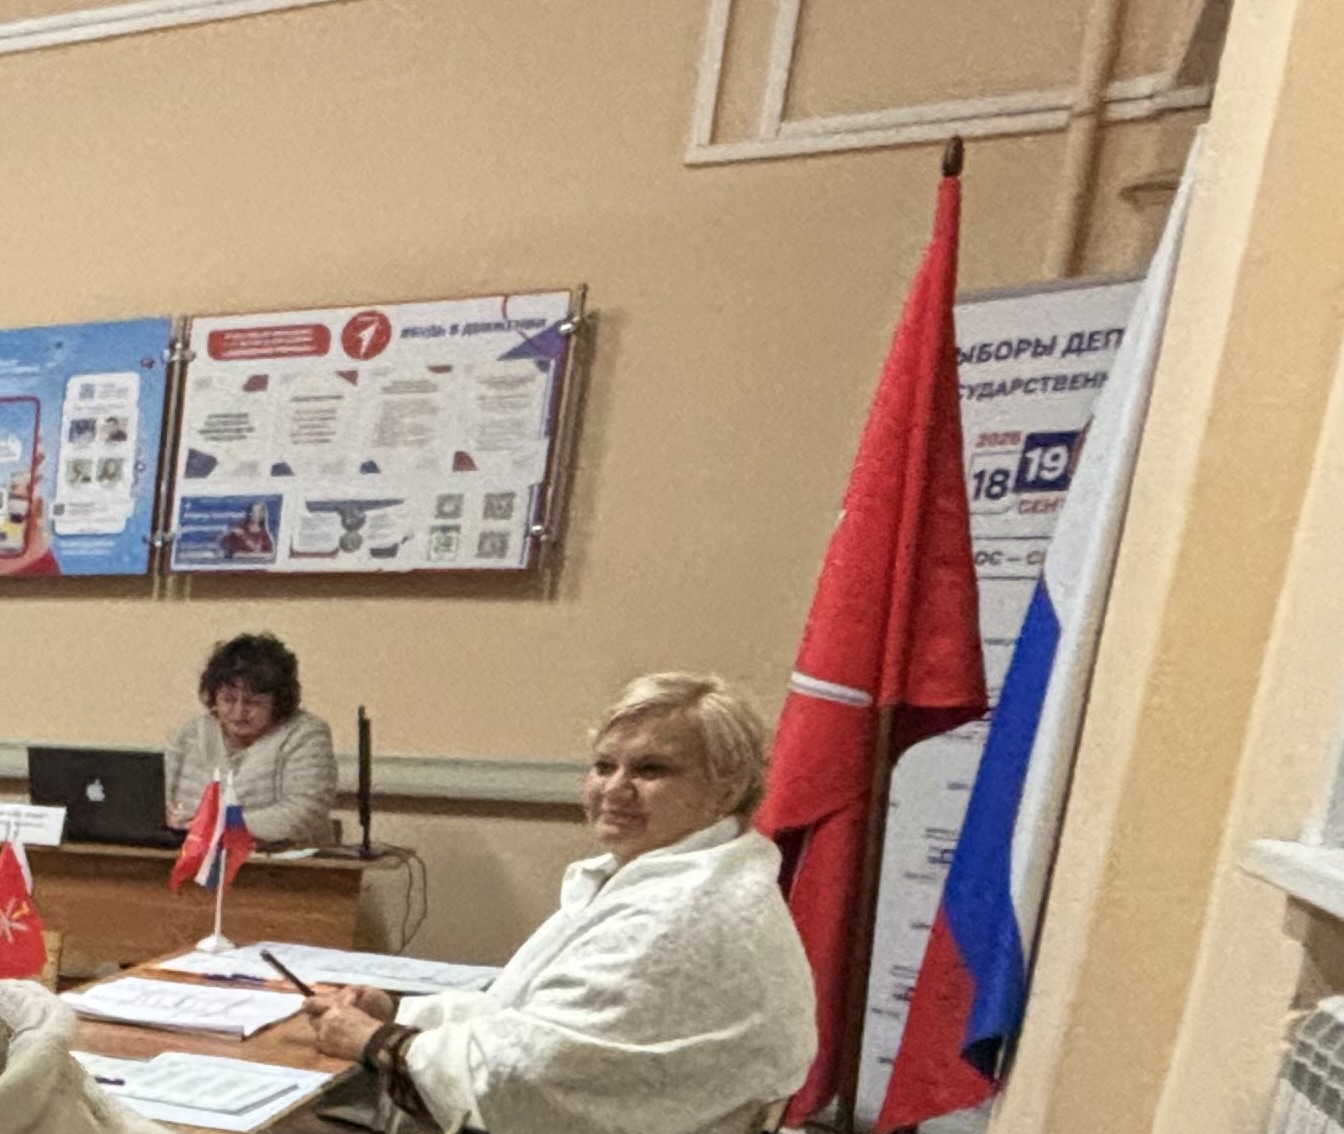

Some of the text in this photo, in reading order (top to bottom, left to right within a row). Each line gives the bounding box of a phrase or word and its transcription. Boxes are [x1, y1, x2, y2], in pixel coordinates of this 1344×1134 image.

[955, 328, 1124, 366] ЫБОРЫ ДЕП
[972, 445, 1069, 501] 18 19
[1017, 498, 1063, 515] СЕН
[1026, 550, 1045, 566] С
